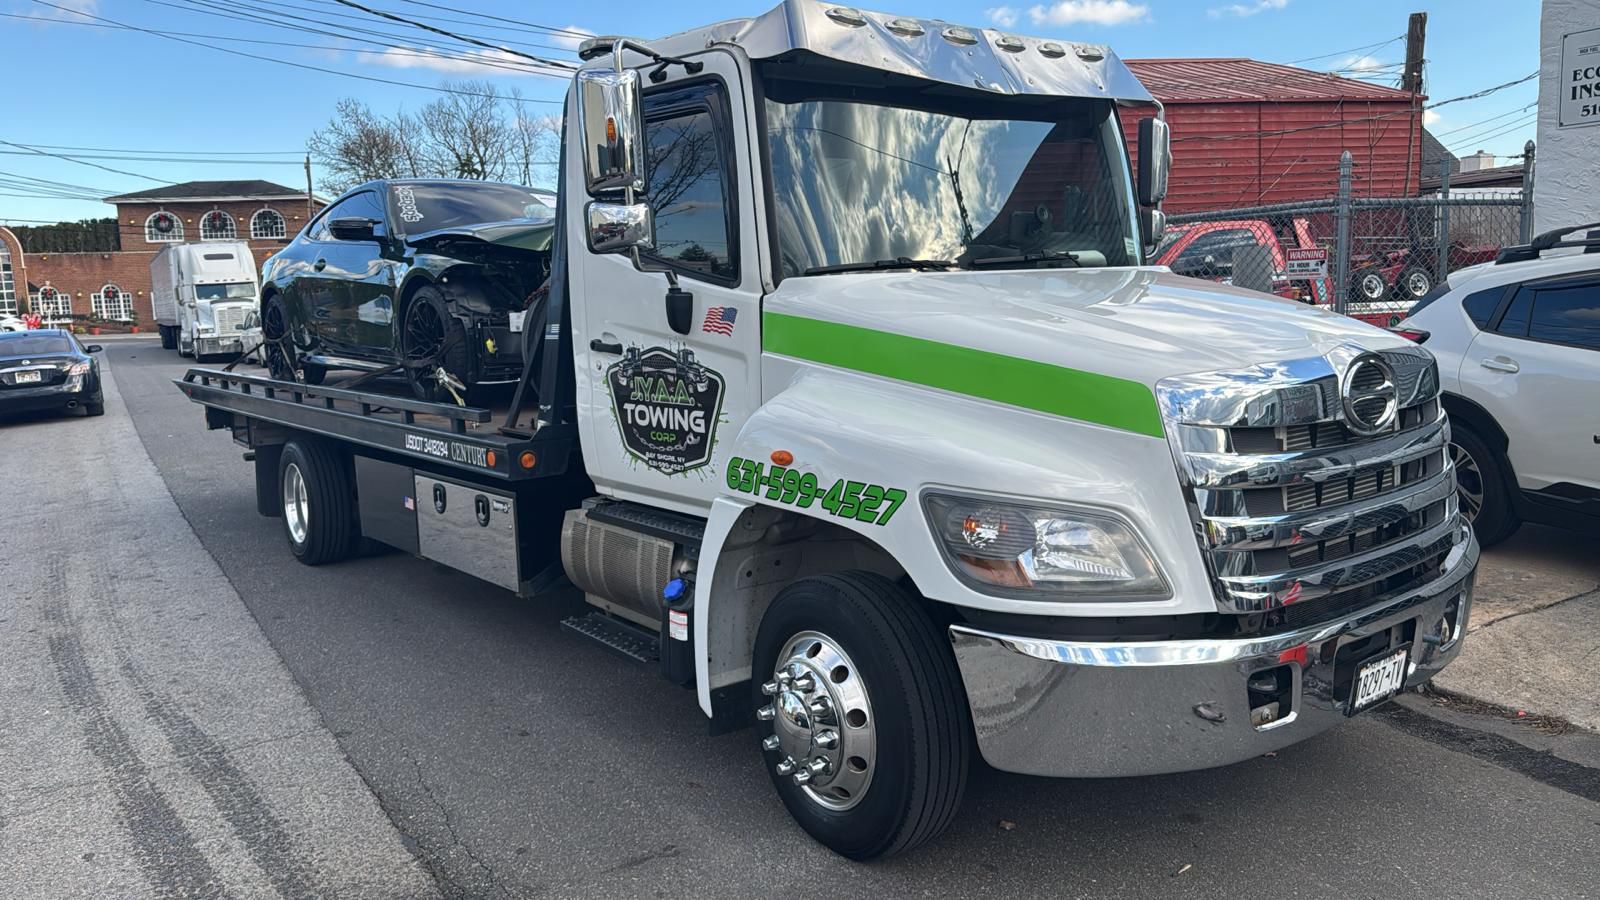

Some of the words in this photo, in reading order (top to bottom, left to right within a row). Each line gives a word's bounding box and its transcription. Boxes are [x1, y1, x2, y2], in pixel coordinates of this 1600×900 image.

[1581, 104, 1600, 117] 51
[1290, 250, 1325, 260] WARNING
[623, 403, 705, 433] TOWING
[405, 433, 424, 452] USDOT
[650, 431, 676, 443] CORP
[451, 442, 487, 467] CENTURY
[727, 457, 907, 526] 631-599-4527
